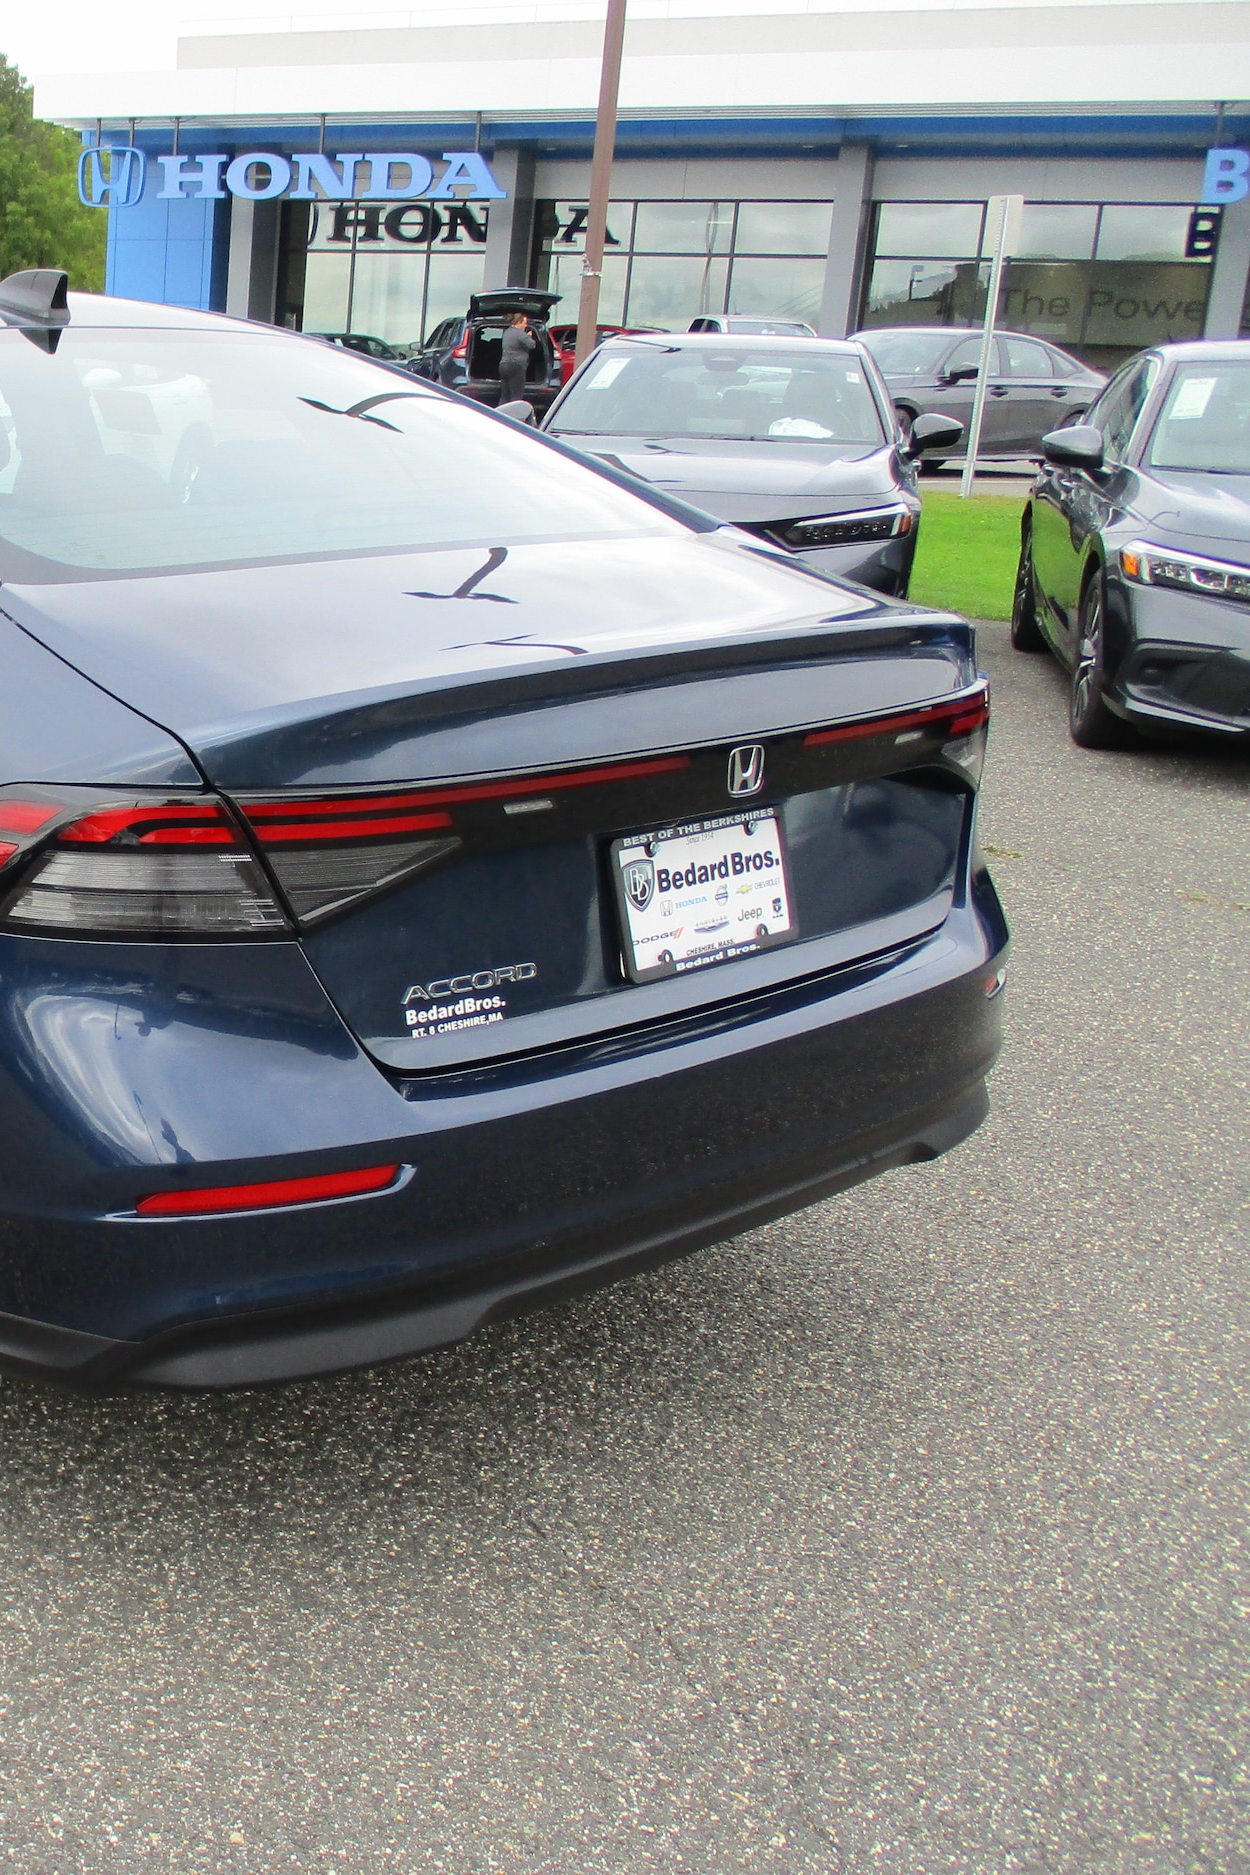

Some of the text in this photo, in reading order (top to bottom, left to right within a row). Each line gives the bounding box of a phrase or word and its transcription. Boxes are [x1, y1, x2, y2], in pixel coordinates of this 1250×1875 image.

[156, 152, 507, 199] HONDA
[1001, 288, 1070, 317] The
[623, 807, 774, 847] BEST OF THE BERKSHIRES
[675, 896, 708, 909] HONDA
[737, 907, 763, 922] Jeep
[633, 930, 678, 946] DODGE
[675, 943, 761, 971] Bedard Bros.
[686, 943, 717, 957] CHESHIRE,
[400, 962, 538, 1005] ACCORD
[412, 1028, 428, 1039] RT.
[429, 1026, 436, 1036] 8
